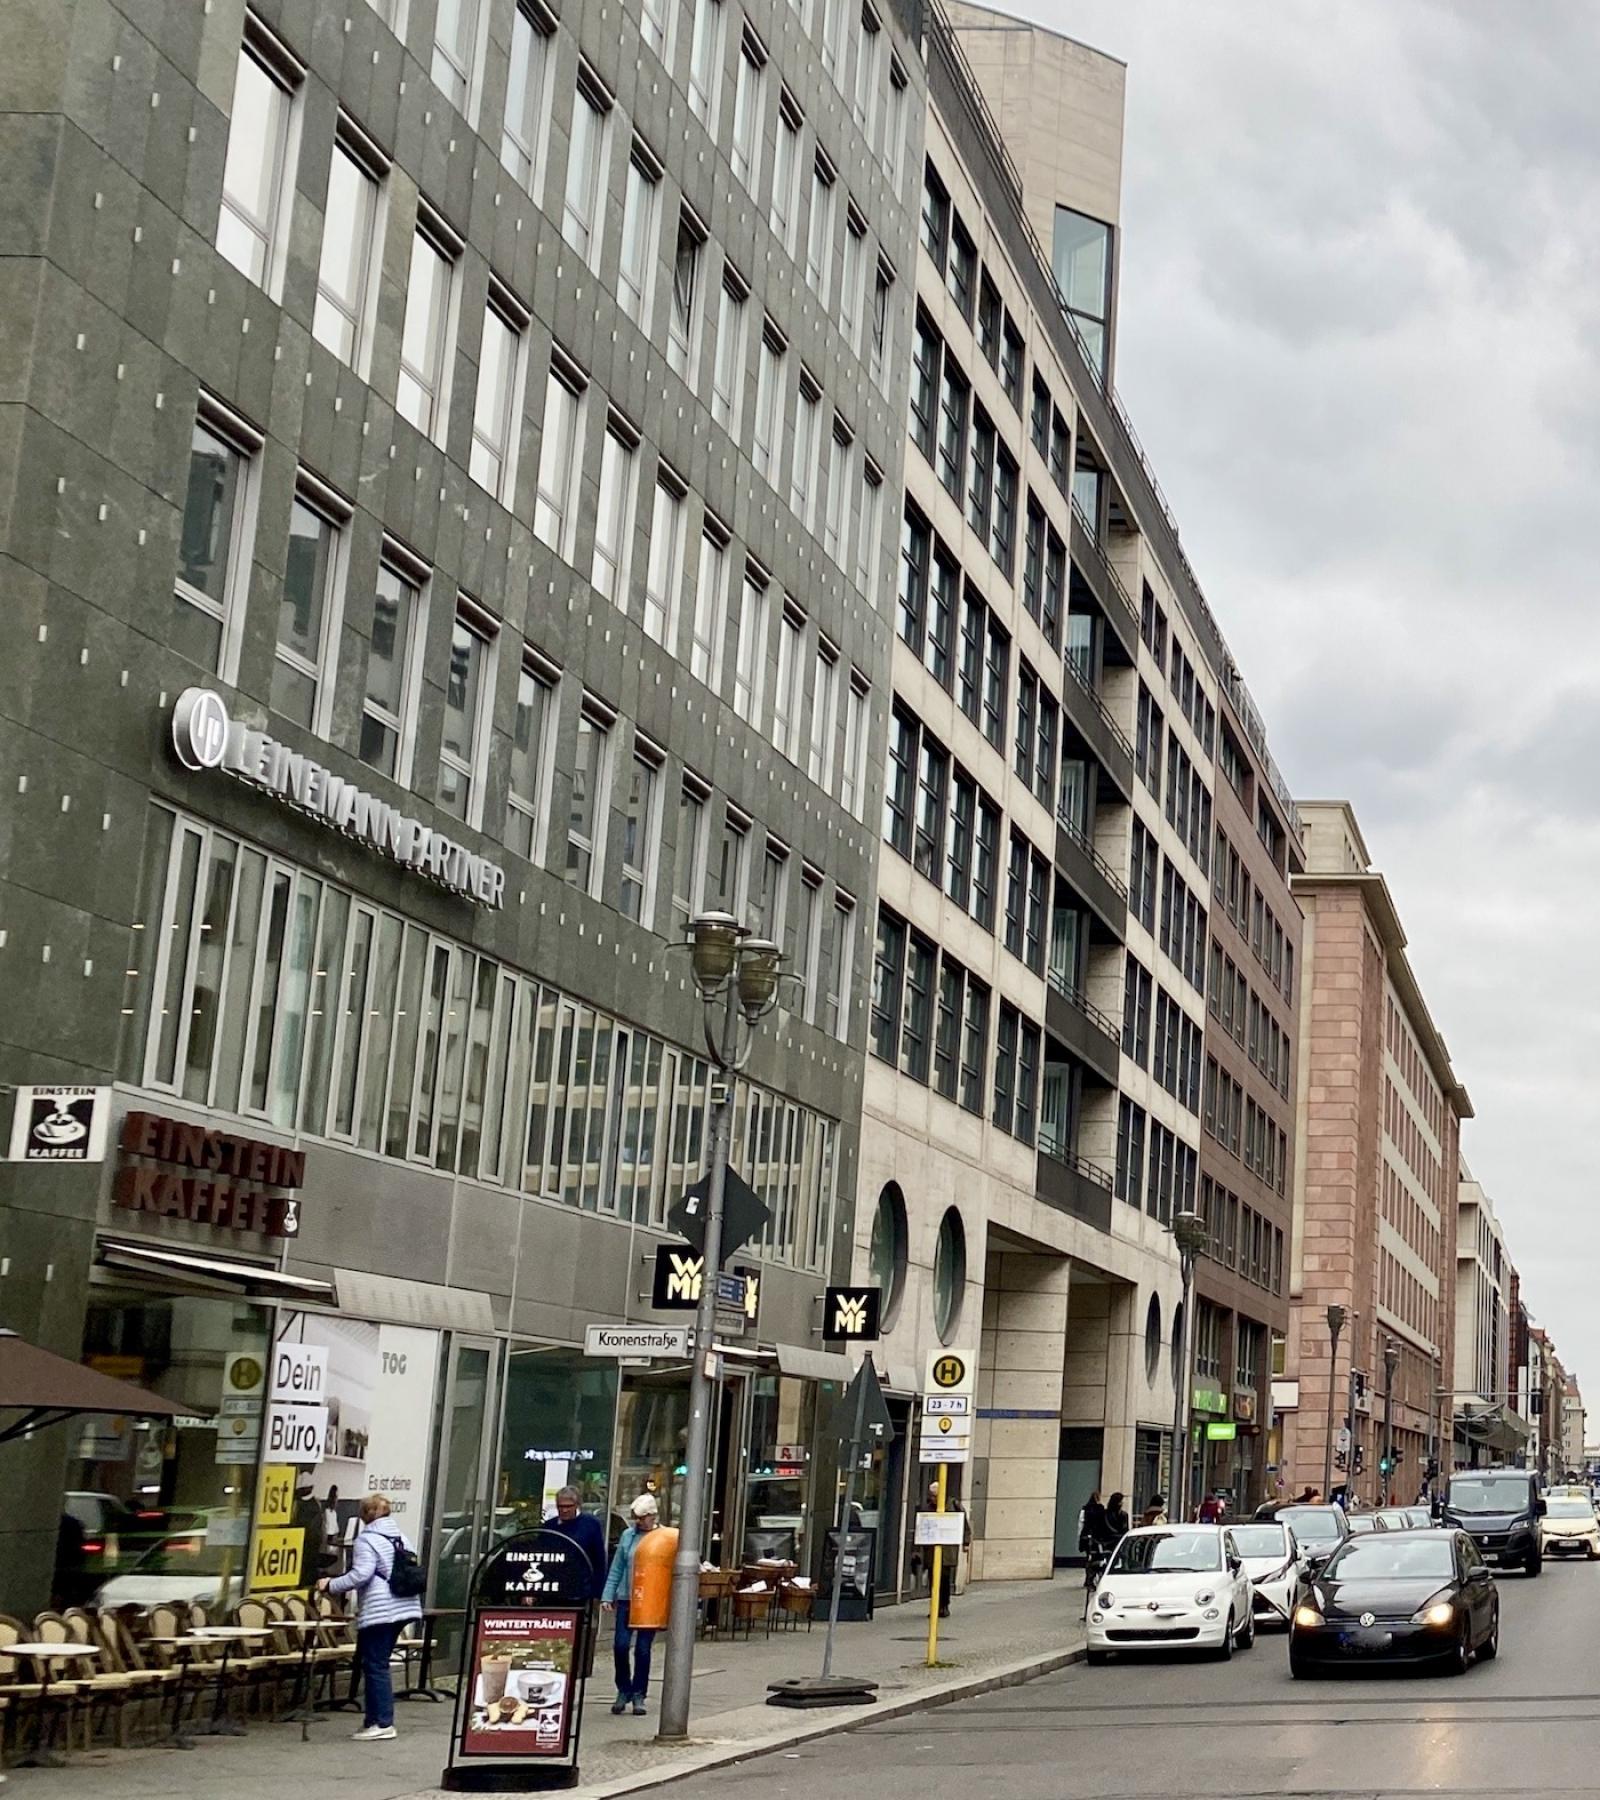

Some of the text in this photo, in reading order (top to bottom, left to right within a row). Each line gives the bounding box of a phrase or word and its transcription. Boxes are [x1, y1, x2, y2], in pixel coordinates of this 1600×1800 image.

[222, 721, 505, 910] LEINEMANN PARTNER
[32, 1086, 96, 1096] EINSTEIN
[28, 1148, 84, 1159] KAFFEE
[137, 1115, 306, 1189] EINSTEIN
[131, 1167, 272, 1235] KAFFEE
[598, 1331, 678, 1349] Kronenstraße
[277, 1353, 321, 1391] Dein
[382, 1351, 407, 1375] TOG
[932, 1401, 942, 1409] 23
[270, 1414, 322, 1460] Büro,
[262, 1476, 289, 1514] ist
[256, 1538, 298, 1577] kein
[505, 1552, 565, 1562] EINSTEIN
[505, 1581, 560, 1592] KAFFEE
[484, 1618, 572, 1630] WINTERTRÄUME
